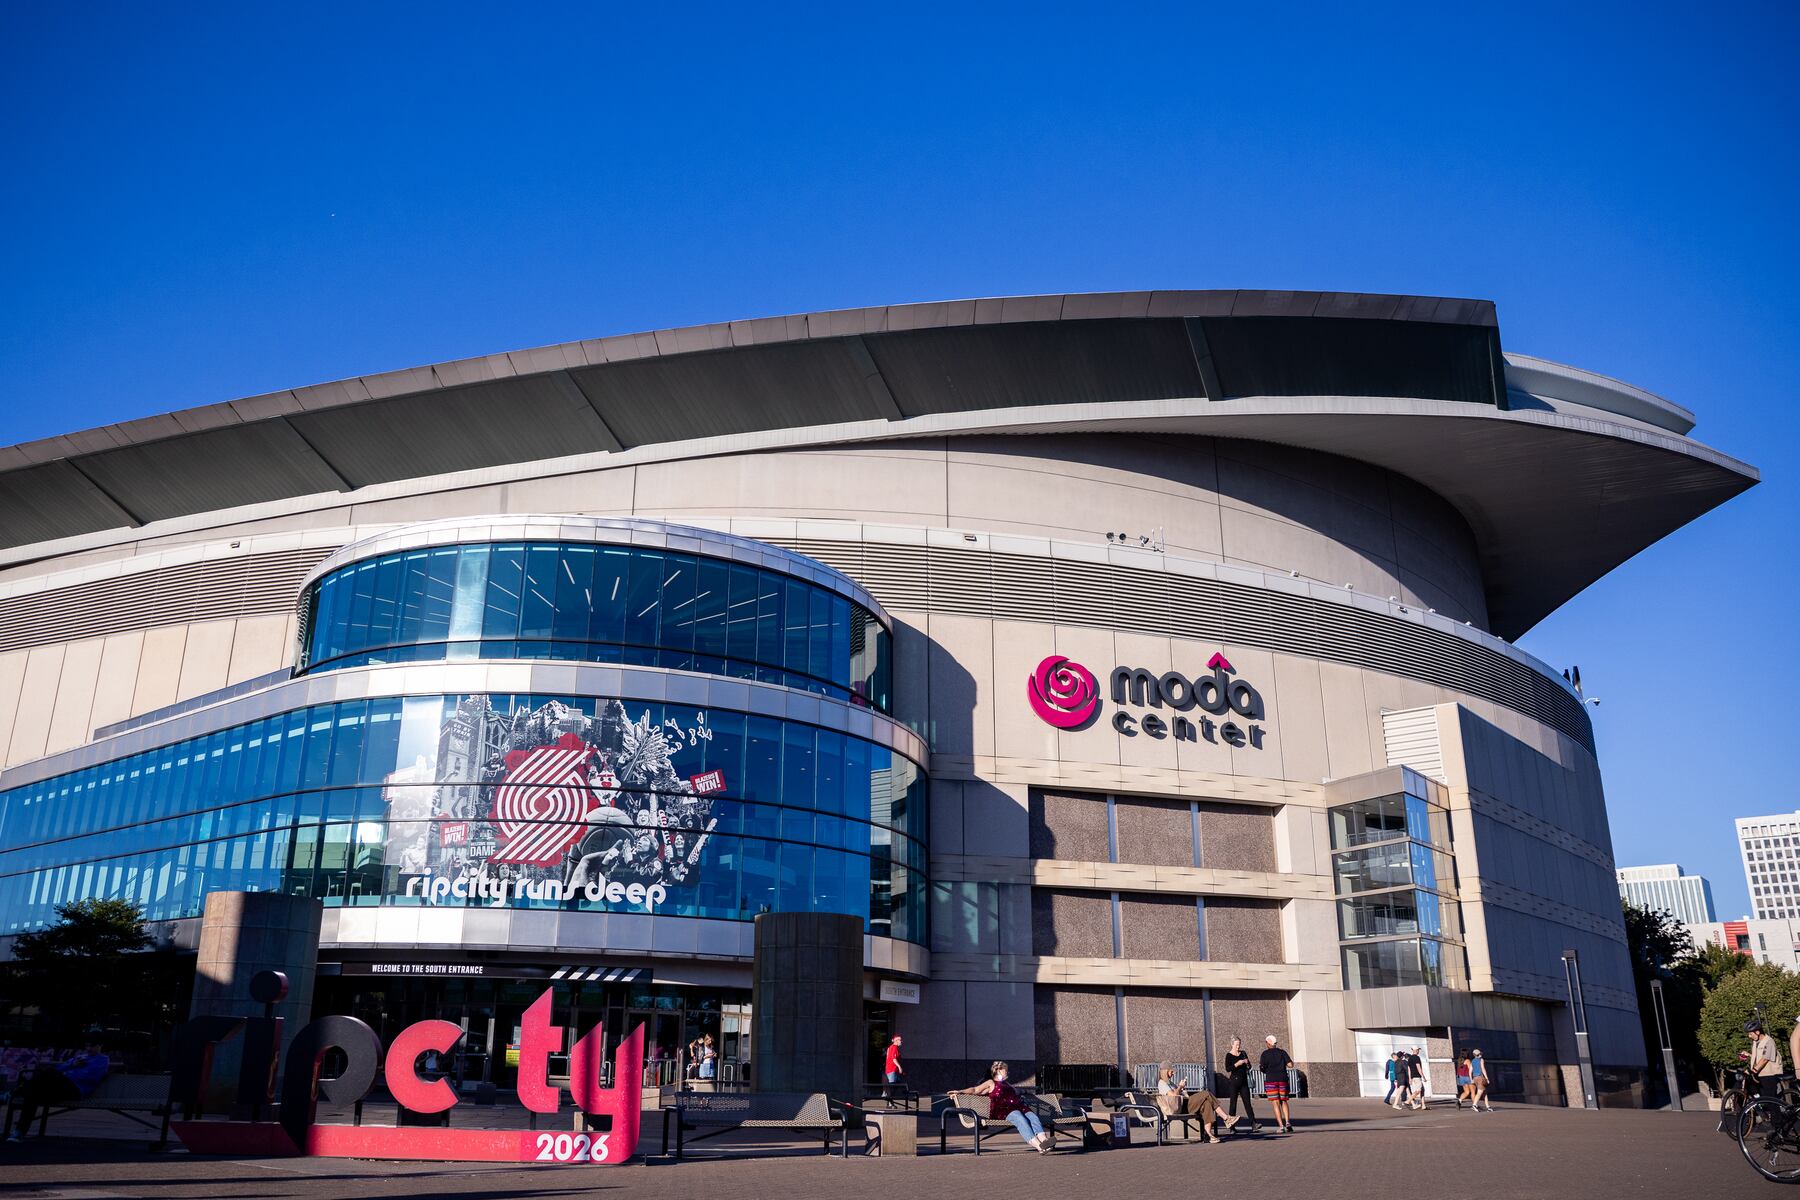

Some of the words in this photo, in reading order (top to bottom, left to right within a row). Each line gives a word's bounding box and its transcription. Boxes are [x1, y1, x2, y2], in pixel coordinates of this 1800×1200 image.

[1110, 652, 1263, 719] moda
[1112, 710, 1265, 749] center
[696, 772, 721, 794] WIN!
[514, 878, 580, 900] runs
[584, 872, 667, 914] deep
[371, 964, 401, 973] WELCOME
[402, 964, 410, 973] TO
[411, 965, 424, 973] THE
[425, 965, 446, 974] SOUTH
[448, 965, 484, 975] ENTRANCE
[535, 1133, 609, 1162] 2026
